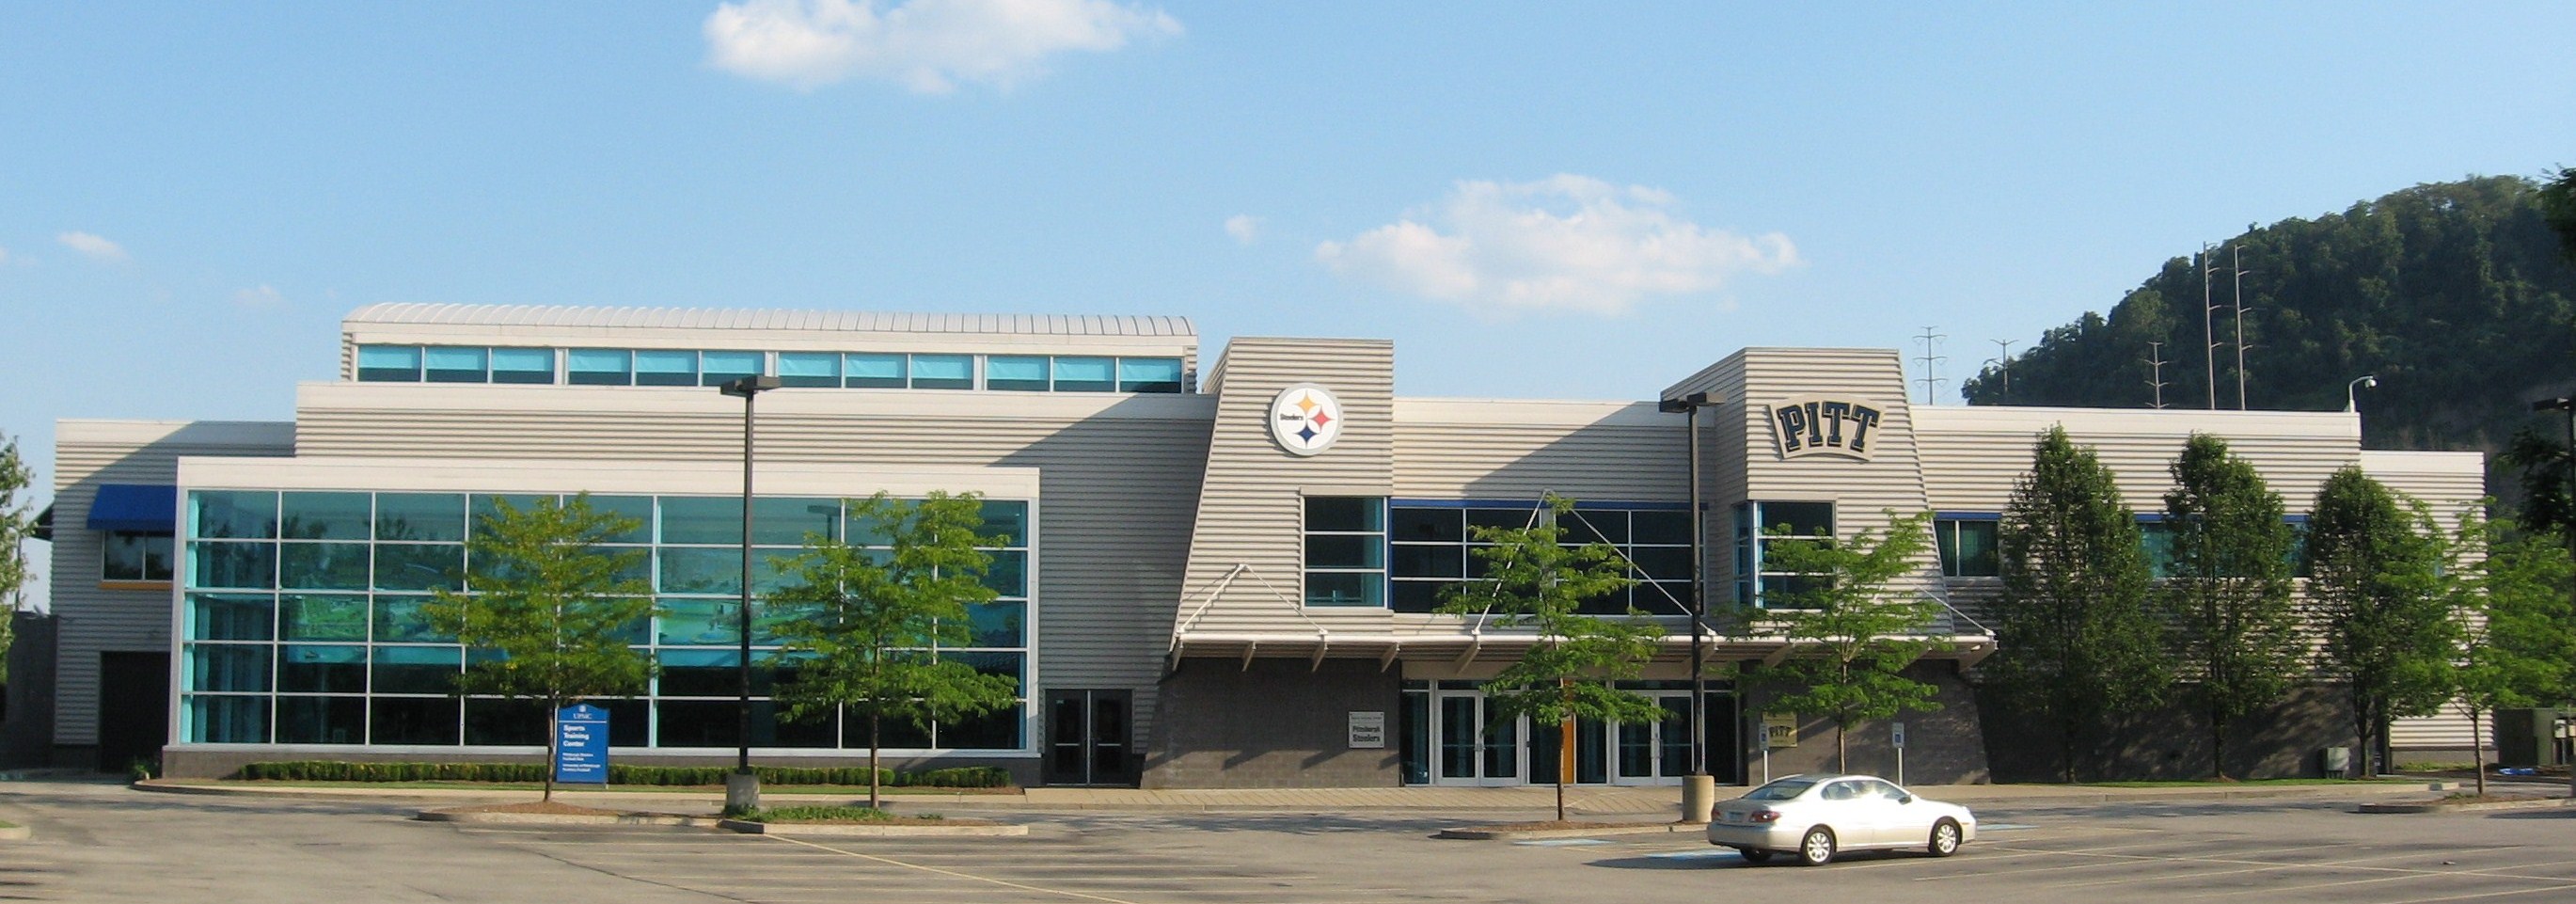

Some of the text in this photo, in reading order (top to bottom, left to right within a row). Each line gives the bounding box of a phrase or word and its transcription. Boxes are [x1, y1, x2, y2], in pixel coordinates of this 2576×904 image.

[1777, 401, 1880, 452] PITT
[563, 732, 590, 740] Training
[1768, 725, 1792, 737] PITT
[1352, 734, 1381, 742] Steelers
